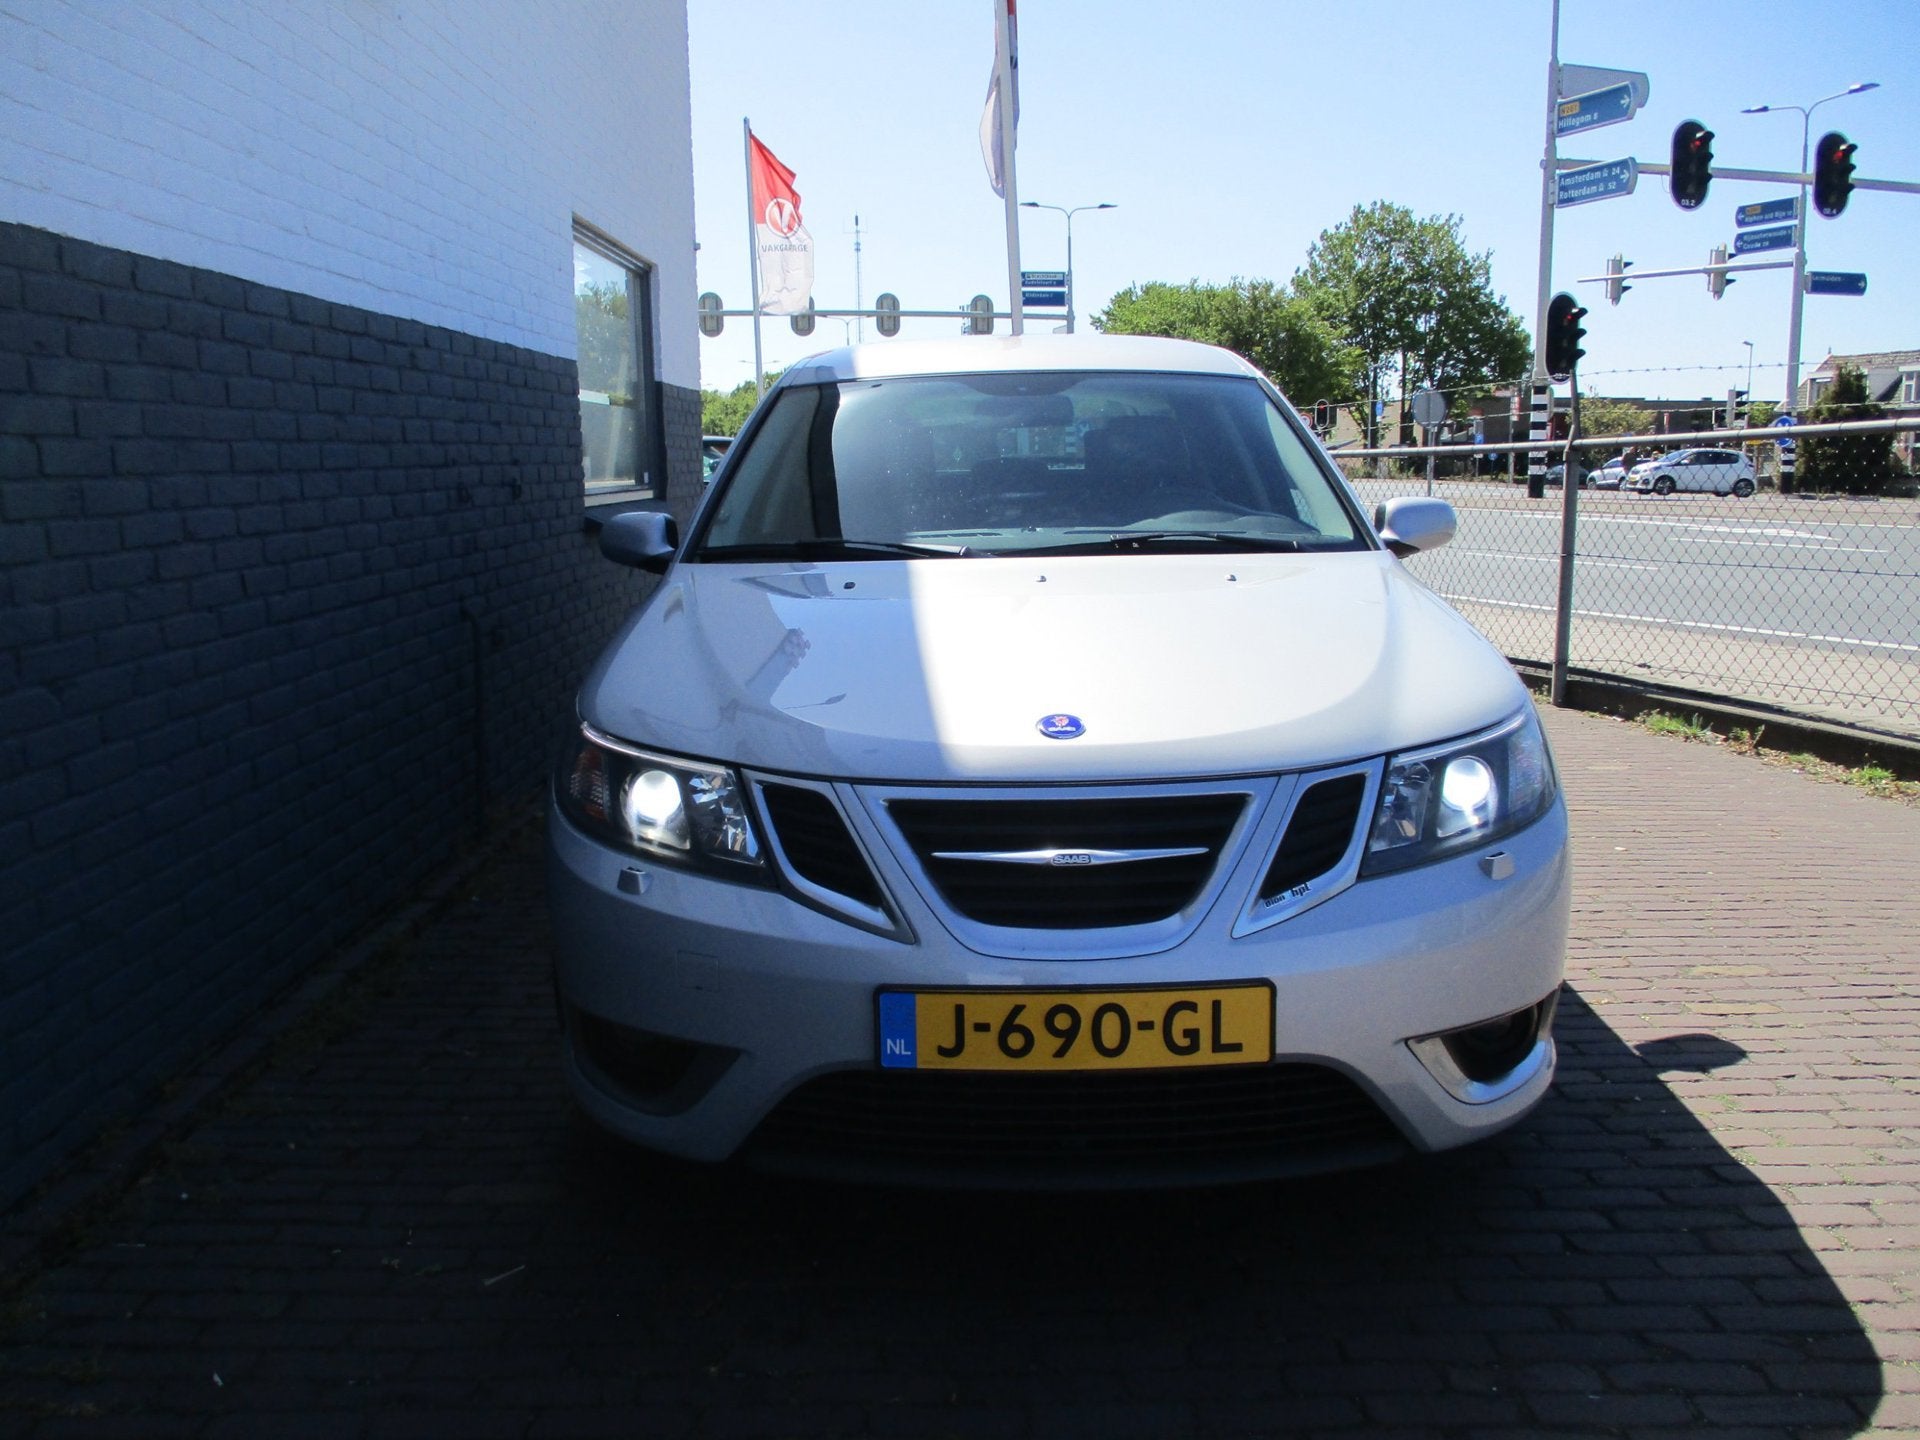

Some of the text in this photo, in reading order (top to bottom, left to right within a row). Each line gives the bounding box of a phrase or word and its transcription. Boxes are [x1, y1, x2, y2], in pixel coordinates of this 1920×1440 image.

[1559, 114, 1591, 129] Hillegom
[1560, 170, 1601, 186] Amsterdam
[1559, 181, 1617, 200] Rotterdam 52
[1053, 854, 1091, 864] SAAB
[886, 999, 1244, 1059] NL J-690-GL
